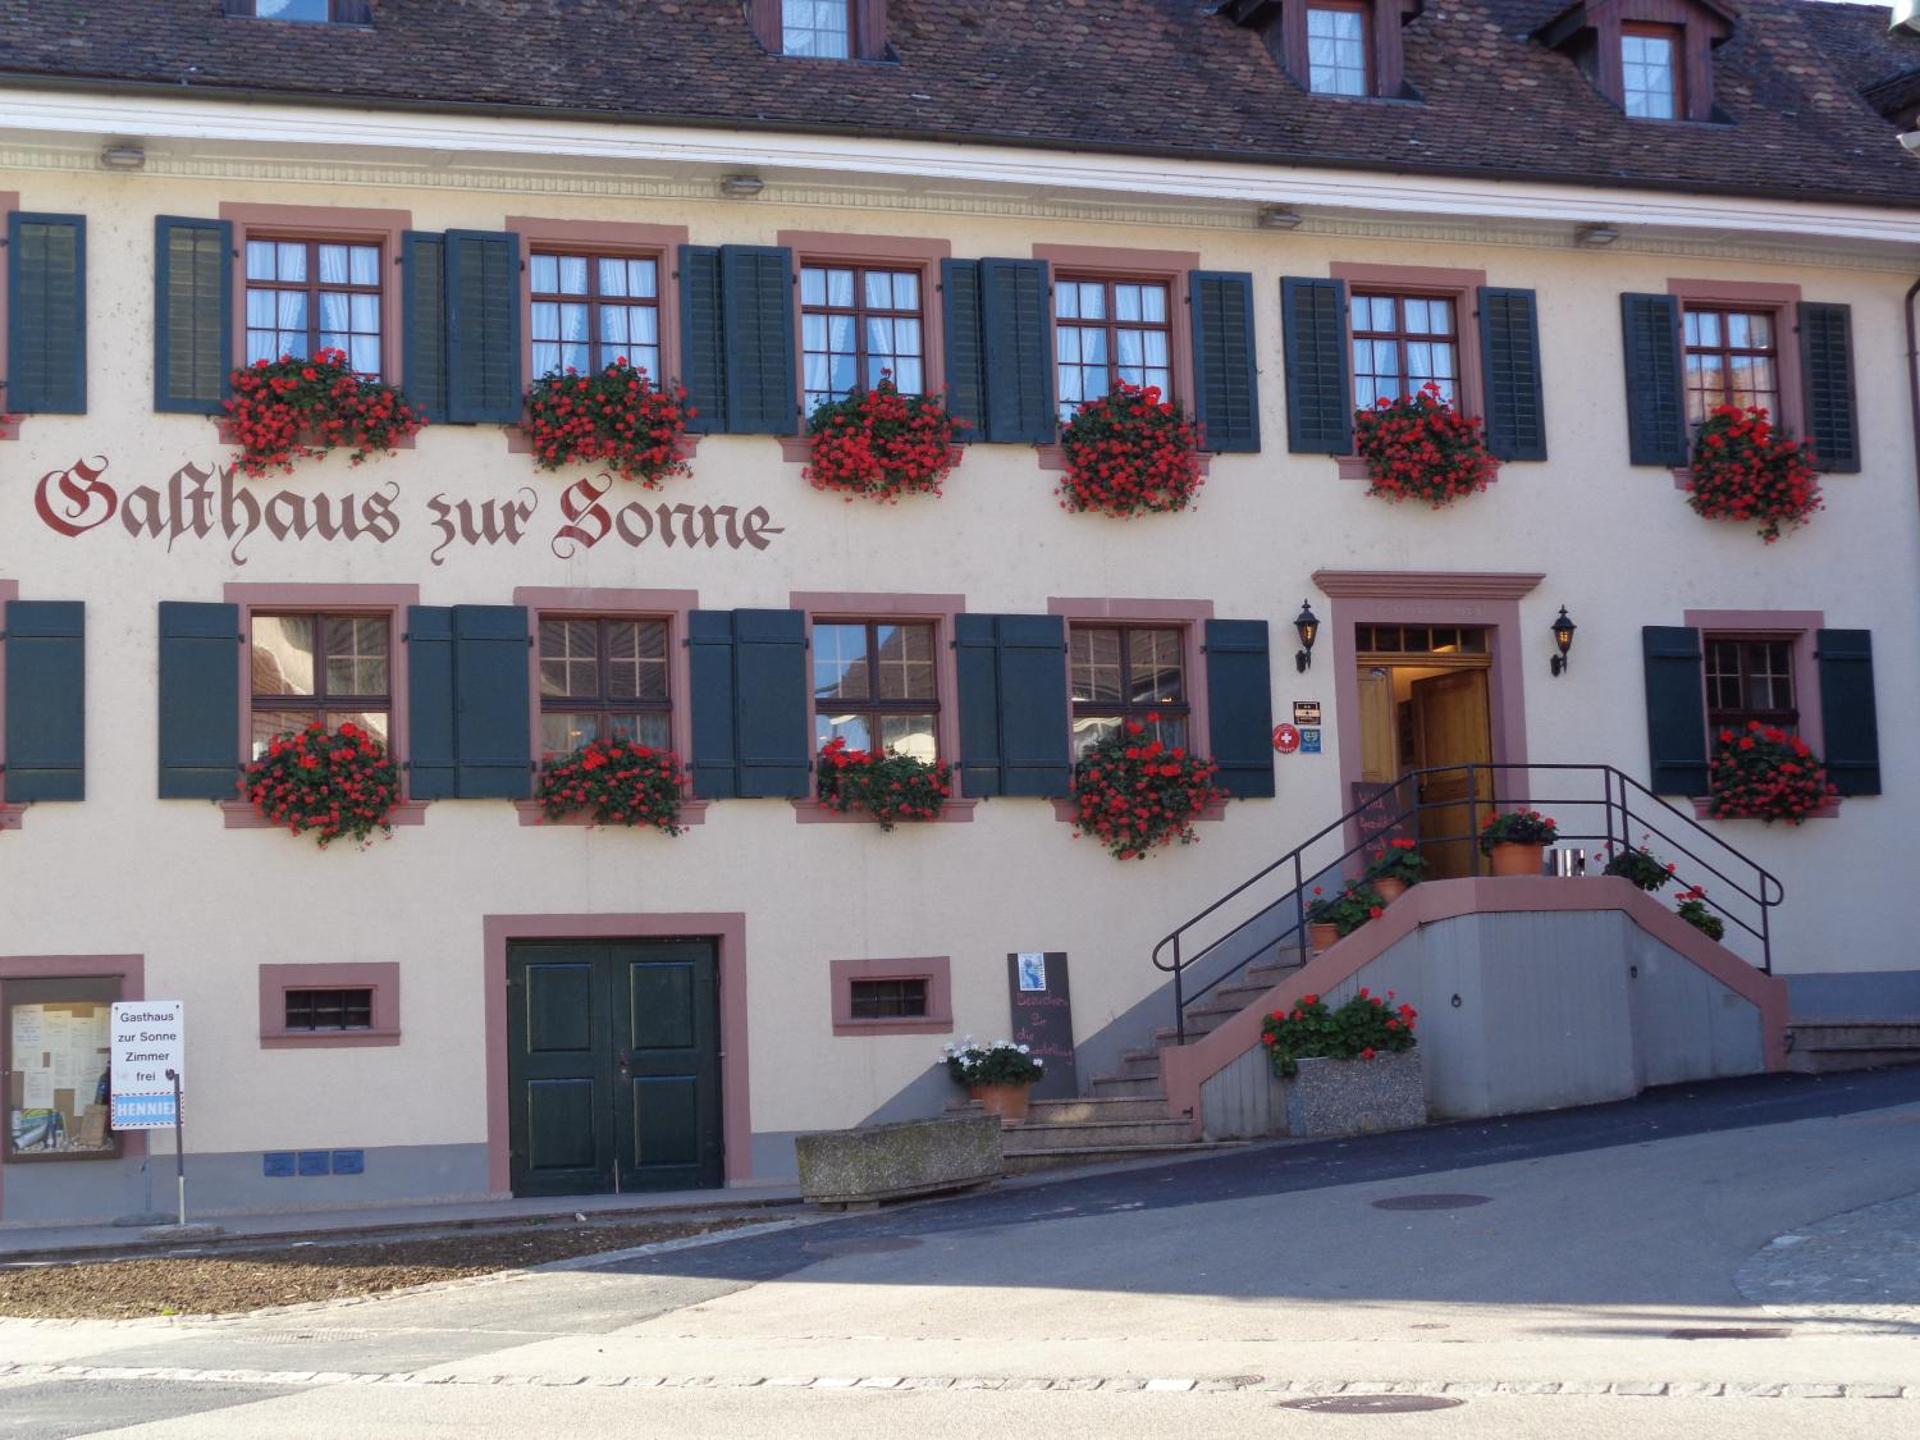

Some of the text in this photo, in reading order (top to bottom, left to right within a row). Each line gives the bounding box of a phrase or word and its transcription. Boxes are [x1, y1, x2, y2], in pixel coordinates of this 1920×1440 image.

[426, 487, 539, 566] zur
[551, 473, 785, 559] Sonne
[120, 1012, 175, 1022] Gasthaus
[118, 1032, 177, 1043] zur Sonne
[125, 1052, 170, 1062] Zimmer
[136, 1072, 156, 1081] frei
